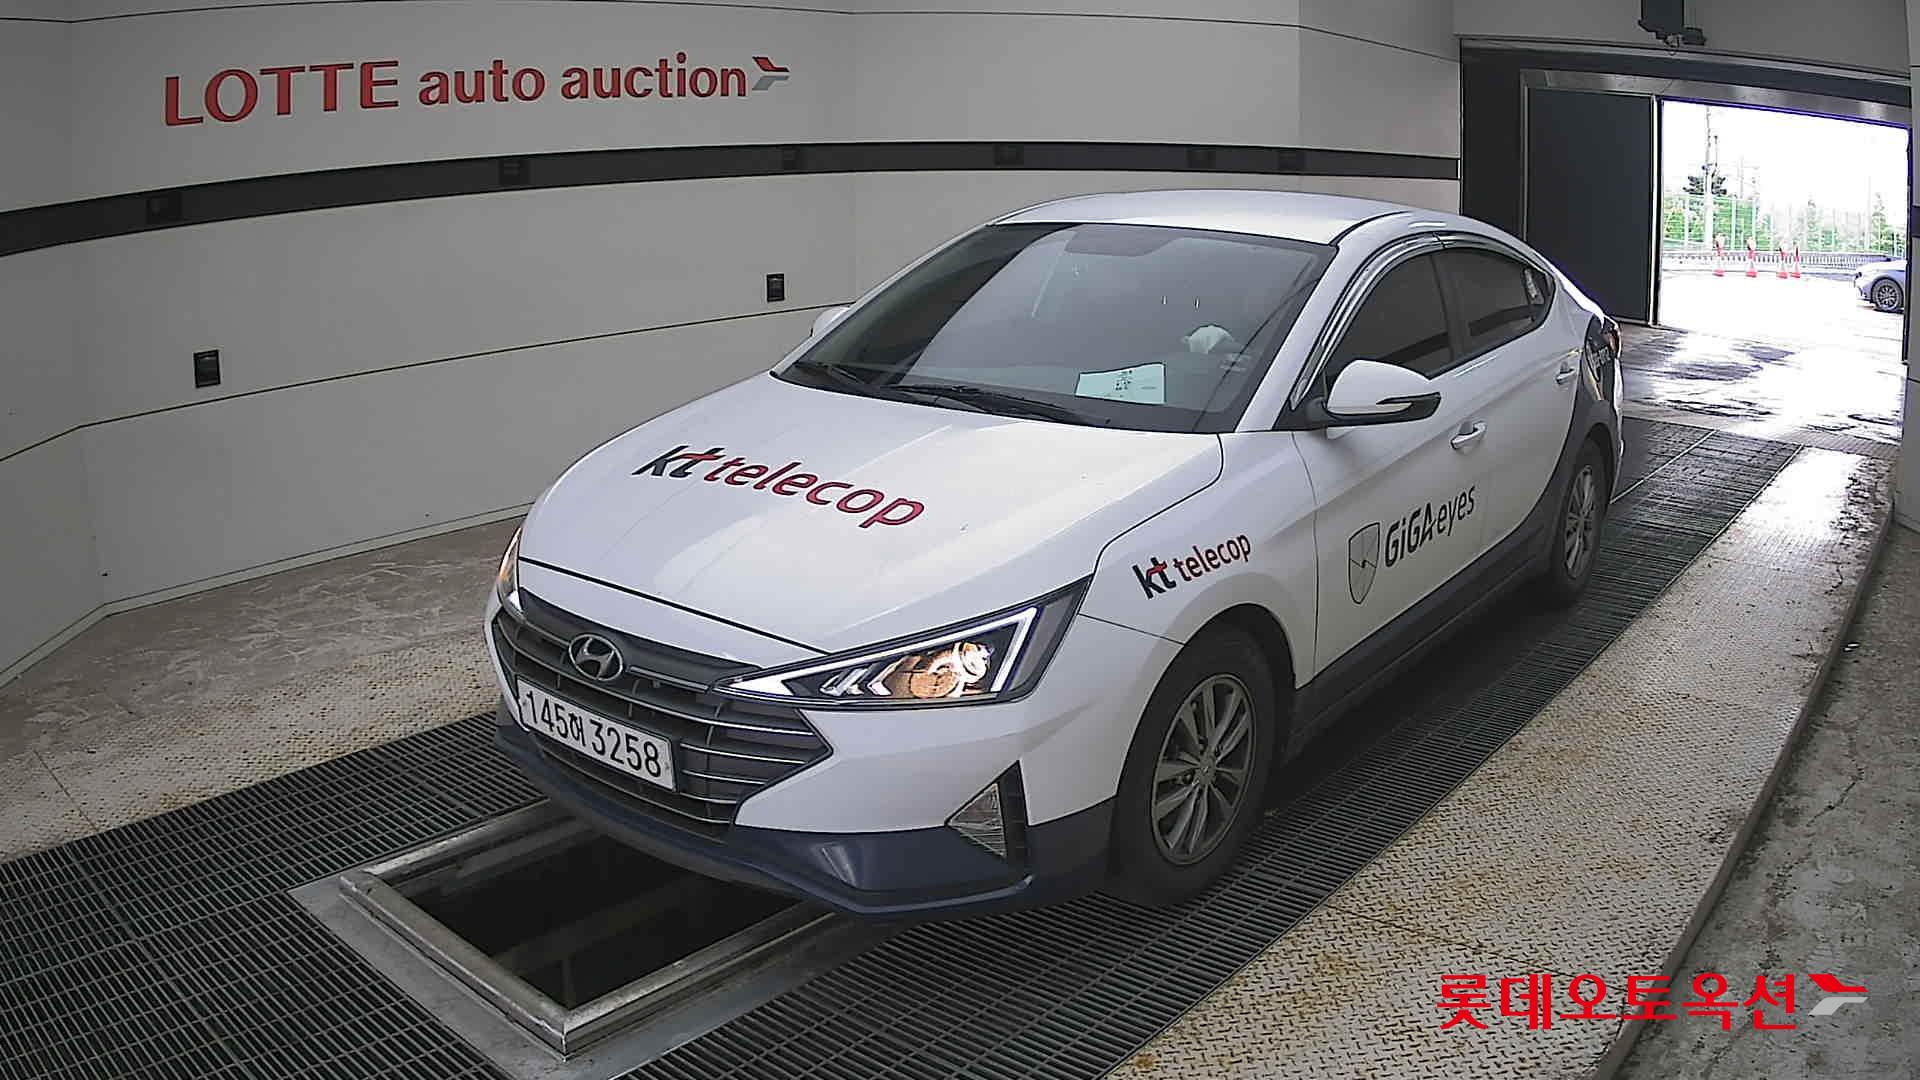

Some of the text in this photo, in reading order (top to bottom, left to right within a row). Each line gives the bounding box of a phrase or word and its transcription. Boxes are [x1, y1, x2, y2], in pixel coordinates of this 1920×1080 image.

[165, 52, 748, 126] LOTTE auto auction
[631, 445, 925, 529] kt telecop
[1132, 534, 1251, 600] kt telecop
[590, 719, 661, 778] 3258
